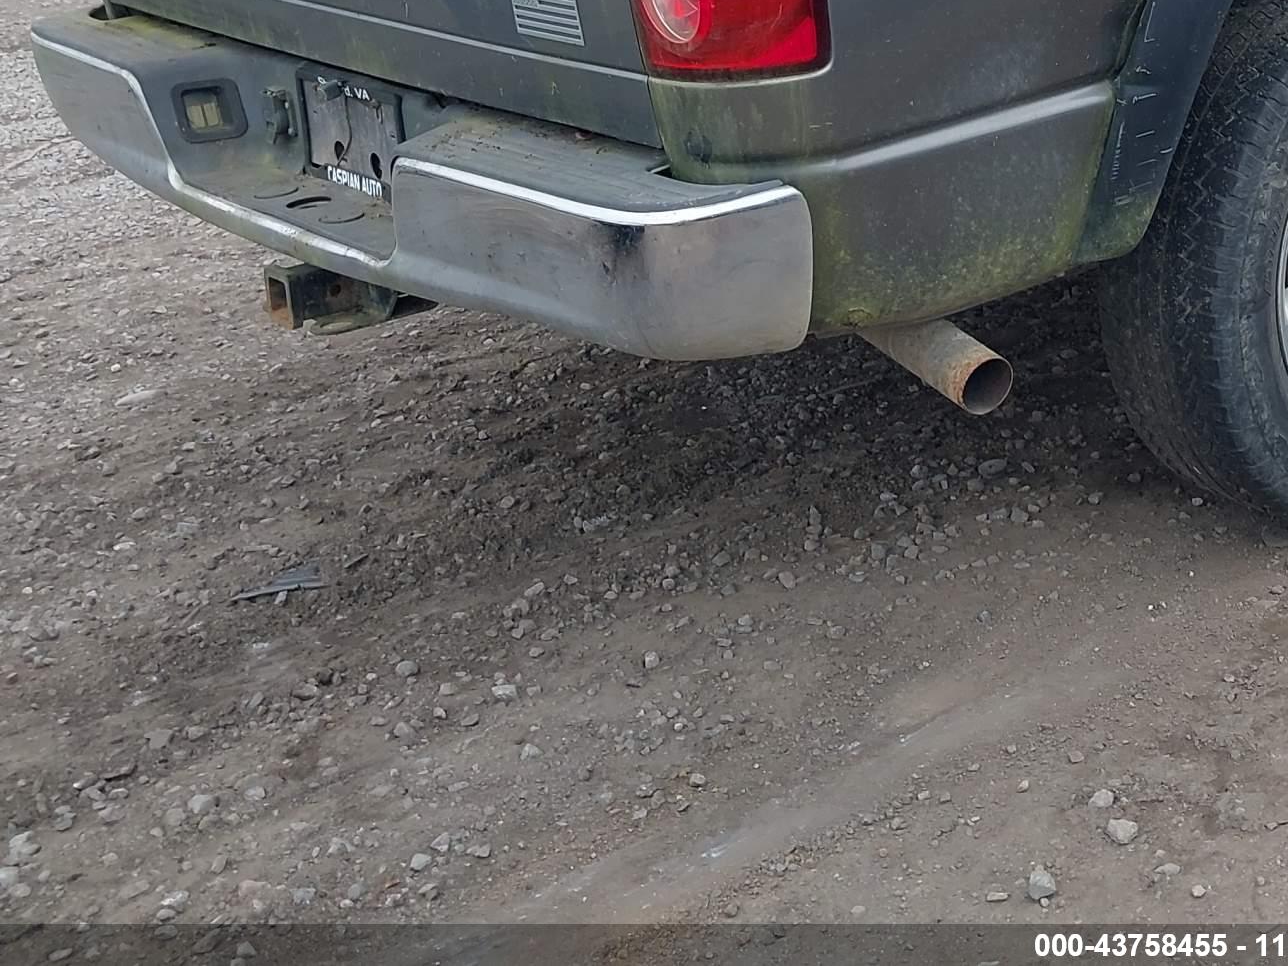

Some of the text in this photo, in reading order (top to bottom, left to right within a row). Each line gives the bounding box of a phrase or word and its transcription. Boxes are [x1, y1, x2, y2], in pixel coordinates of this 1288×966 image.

[353, 87, 371, 101] VA
[327, 165, 383, 198] CASPIAN AUTO
